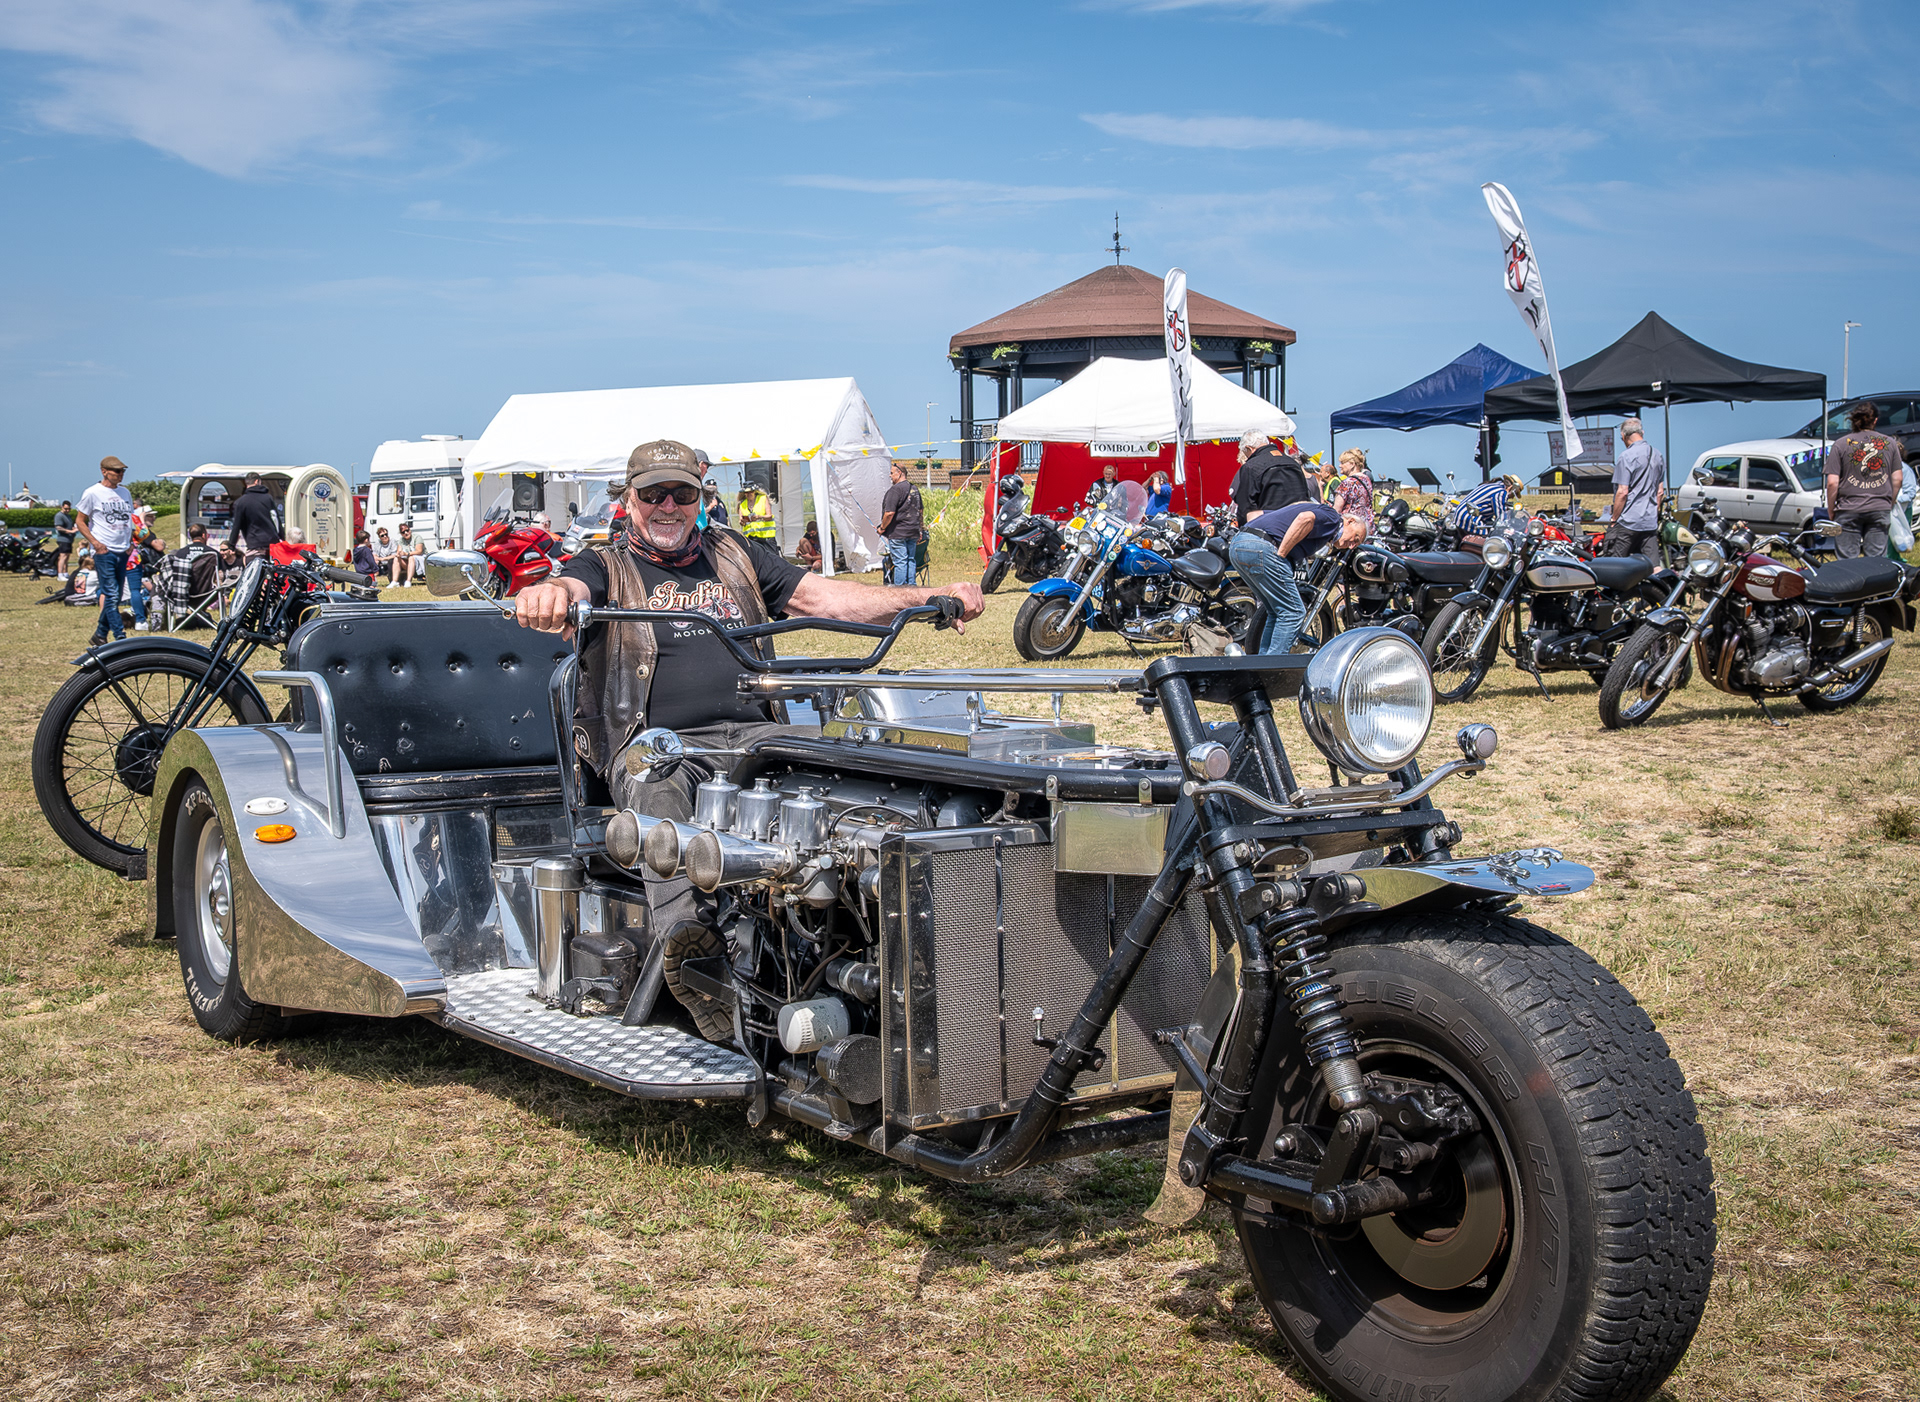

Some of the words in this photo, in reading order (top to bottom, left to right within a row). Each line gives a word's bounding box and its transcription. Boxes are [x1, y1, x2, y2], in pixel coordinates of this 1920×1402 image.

[1094, 443, 1145, 453] TOMBOLA
[653, 452, 681, 462] Sprint
[1847, 475, 1860, 487] LOS
[647, 580, 732, 611] Indian
[1345, 978, 1522, 1102] UELER
